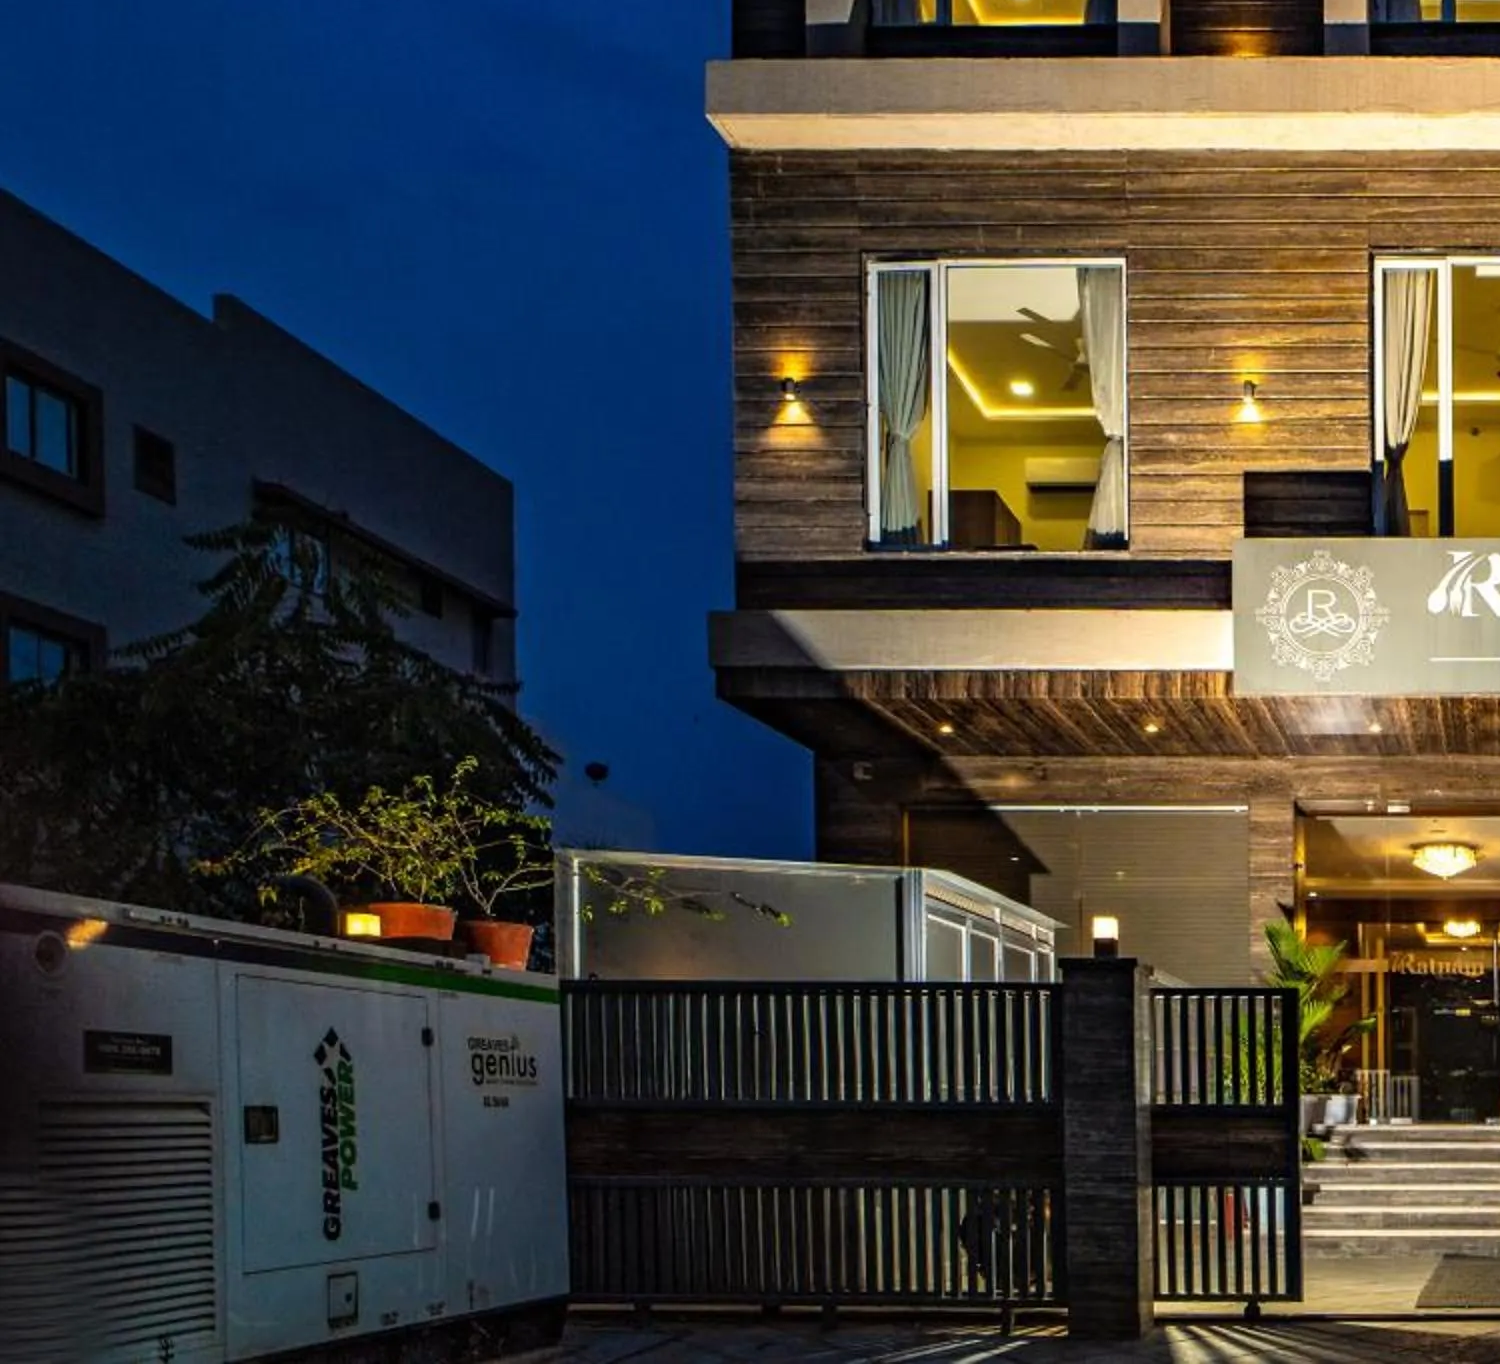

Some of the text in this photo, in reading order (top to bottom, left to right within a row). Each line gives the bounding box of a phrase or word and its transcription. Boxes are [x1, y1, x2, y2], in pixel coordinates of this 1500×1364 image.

[1308, 589, 1336, 622] R
[471, 1053, 537, 1086] genius
[321, 1086, 341, 1240] GREAVES
[337, 1060, 358, 1190] POWER
